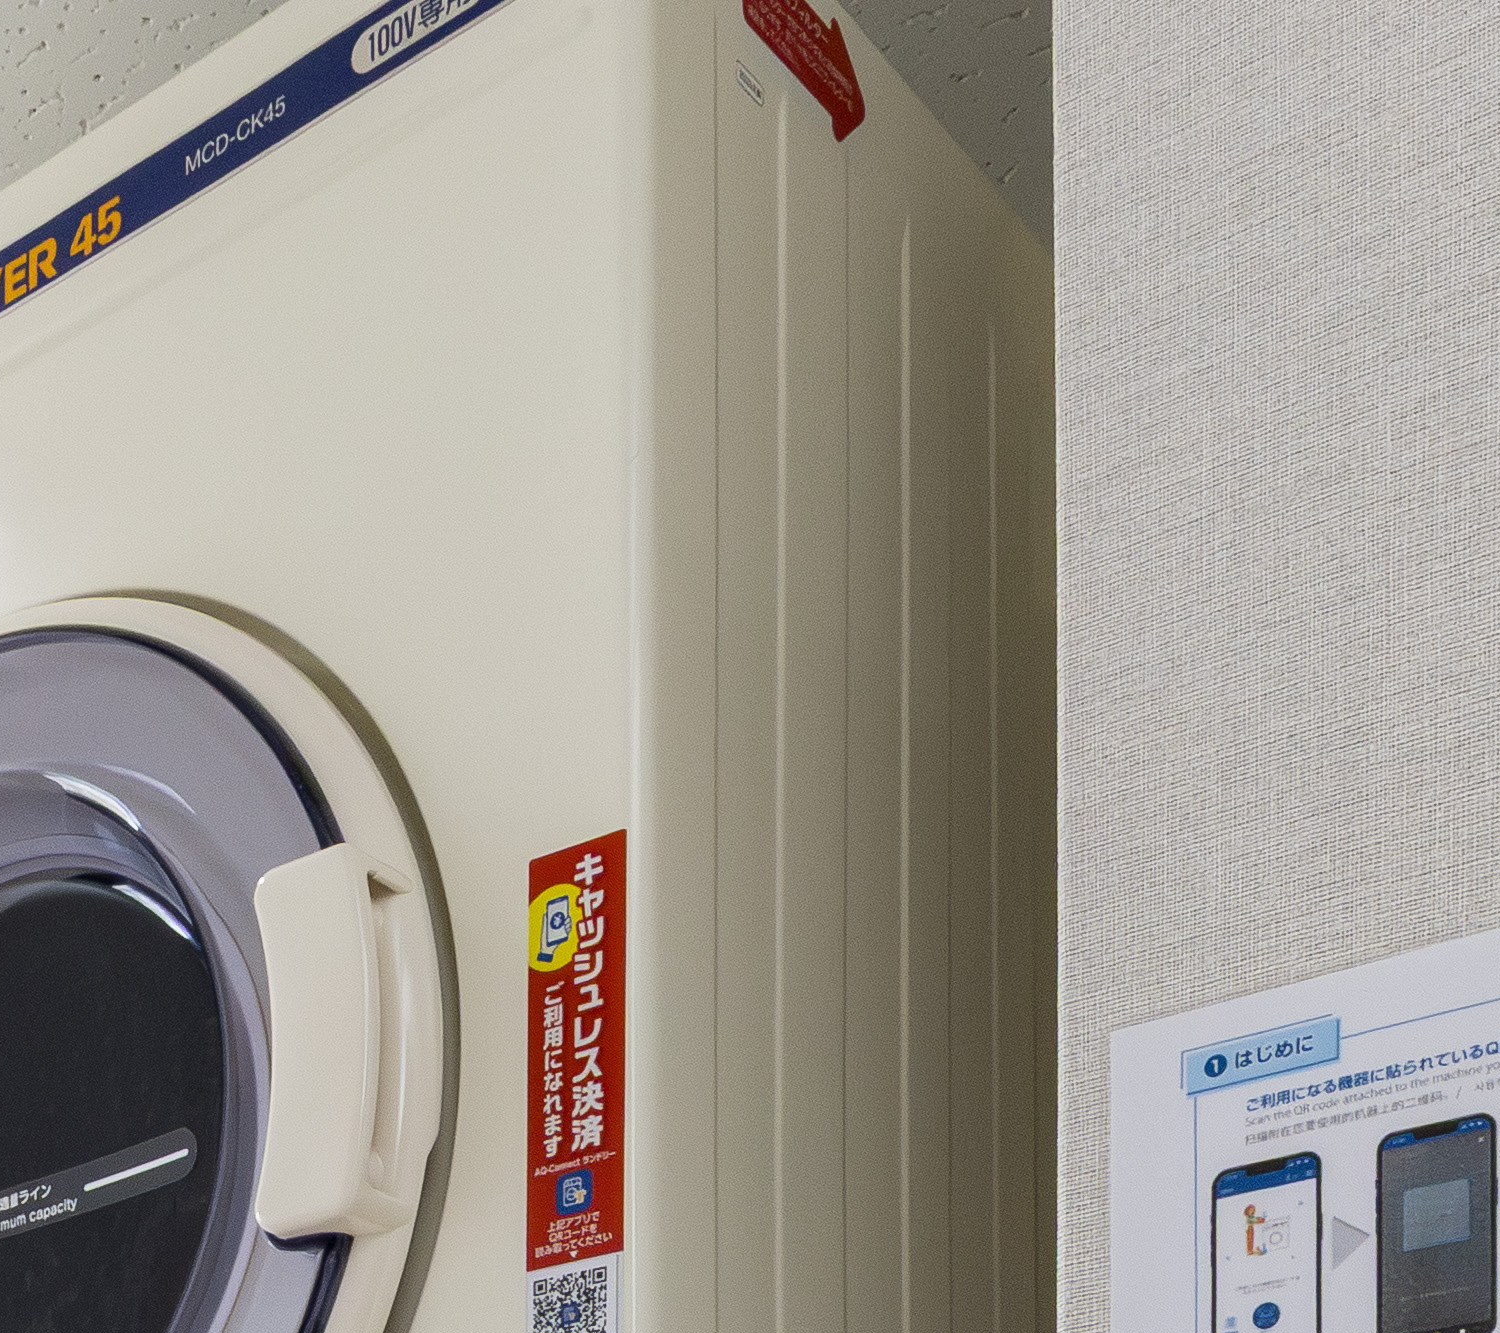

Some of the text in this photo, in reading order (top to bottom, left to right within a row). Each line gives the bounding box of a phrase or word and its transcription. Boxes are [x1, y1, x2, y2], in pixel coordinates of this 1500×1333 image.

[184, 94, 287, 177] MCD-CK45
[70, 198, 124, 257] 45
[570, 851, 605, 1154] キャッシュレス決済
[541, 981, 564, 1160] ご利用になれます
[1234, 1034, 1314, 1070] はじめに
[1245, 1112, 1271, 1127] Scan
[1273, 1108, 1292, 1121] the
[1293, 1103, 1311, 1119] QR
[1312, 1097, 1340, 1112] code
[1342, 1085, 1393, 1105] attached
[1395, 1082, 1408, 1093] to
[1410, 1075, 1430, 1089] the
[1432, 1064, 1482, 1084] machine
[29, 1196, 79, 1224] capacity
